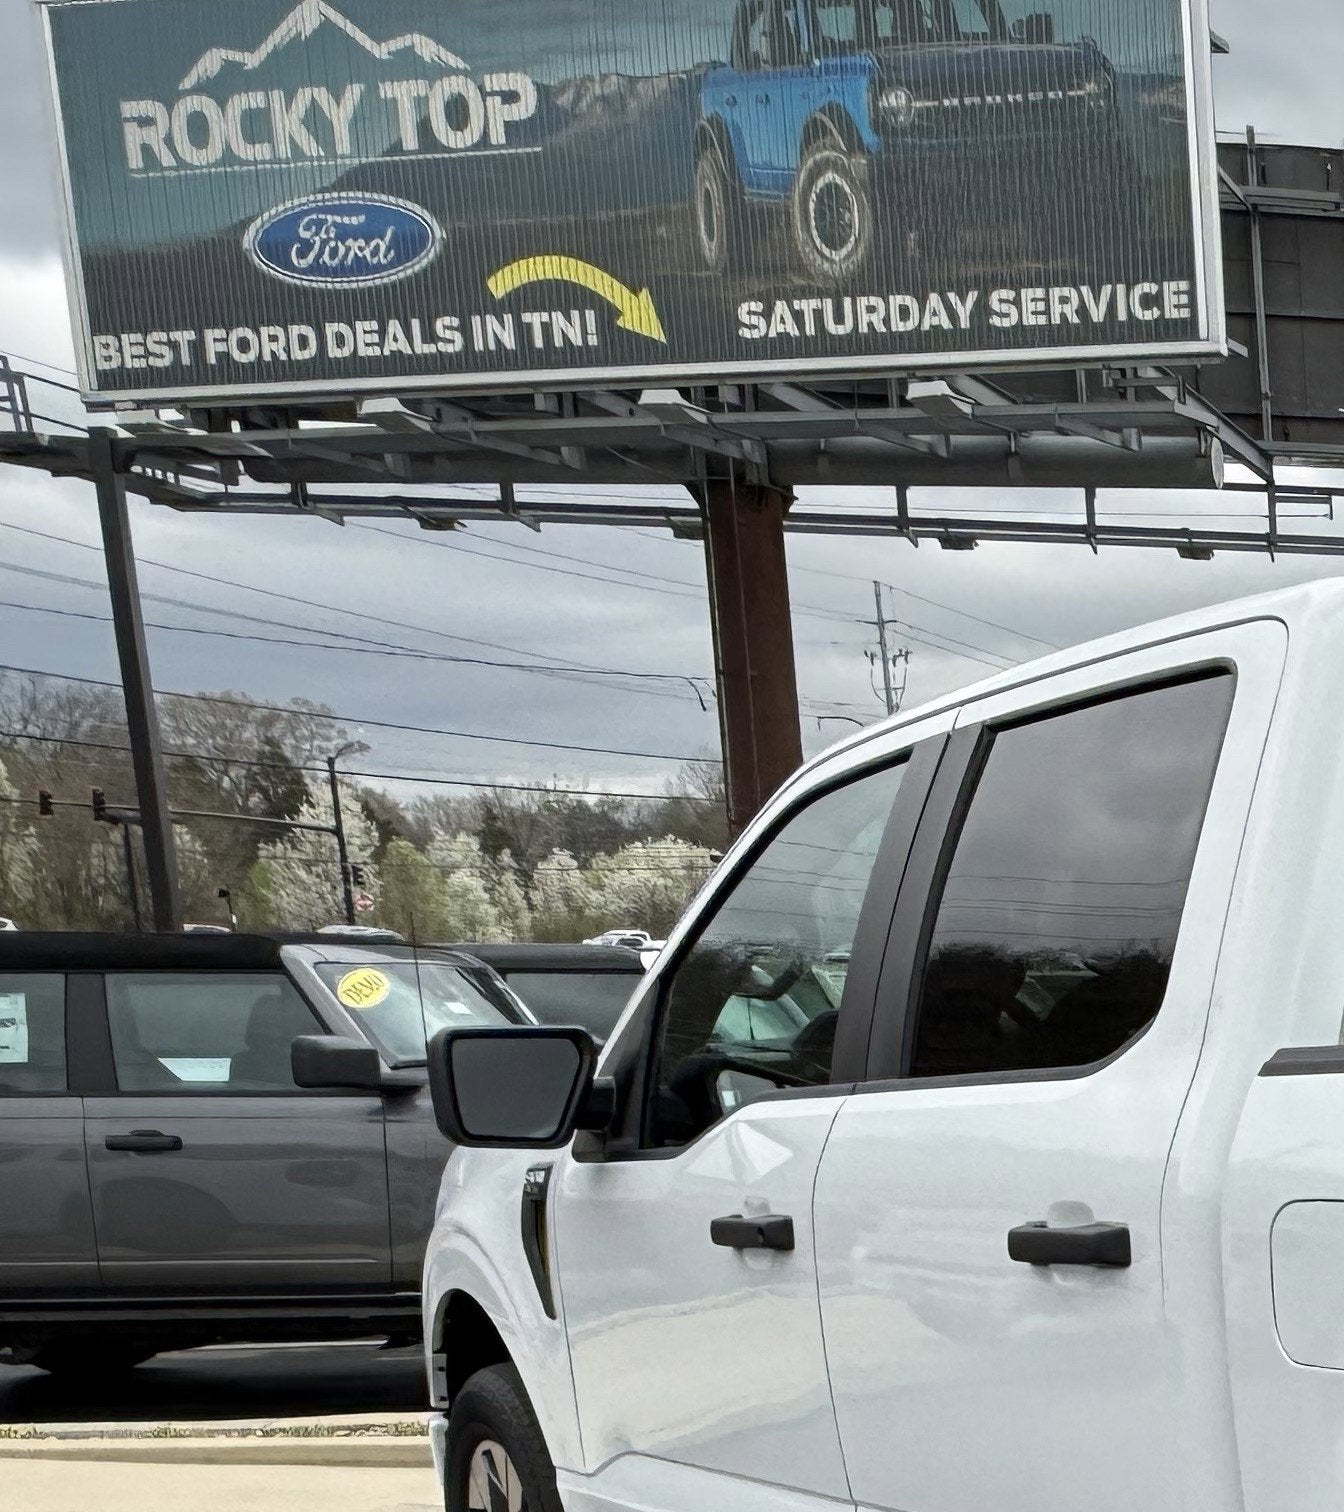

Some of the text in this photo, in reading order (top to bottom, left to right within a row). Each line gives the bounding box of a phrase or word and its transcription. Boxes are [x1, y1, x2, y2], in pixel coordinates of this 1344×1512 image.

[121, 72, 539, 171] ROCKY TOP
[291, 213, 395, 268] Ford
[94, 308, 598, 370] BEST FORD DEALS IN TN!
[737, 280, 1191, 341] SATURDAY SERVICE
